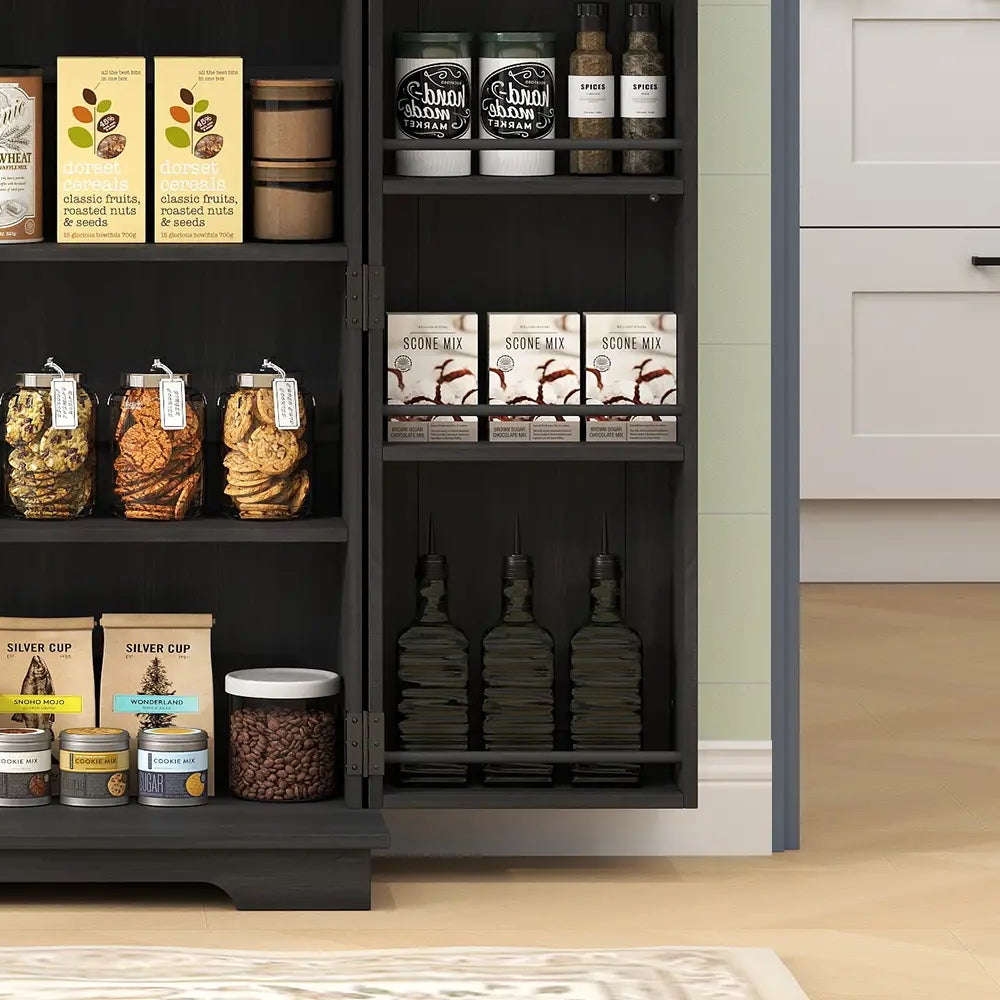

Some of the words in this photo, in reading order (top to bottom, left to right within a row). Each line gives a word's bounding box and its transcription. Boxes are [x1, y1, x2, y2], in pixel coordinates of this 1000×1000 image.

[63, 160, 121, 175] dorset
[160, 160, 218, 175] dorset
[63, 177, 128, 192] cereals
[160, 177, 226, 192] cereals
[64, 194, 102, 204] classic
[106, 194, 141, 206] fruits,
[160, 194, 199, 204] classic
[203, 194, 238, 206] fruits,
[64, 206, 107, 216] roasted
[110, 207, 136, 216] nuts
[160, 206, 204, 216] roasted
[207, 207, 233, 216] nuts
[64, 218, 73, 227] &
[76, 218, 108, 227] seeds
[160, 218, 170, 227] &
[174, 218, 205, 227] seeds
[404, 336, 438, 350] SCONE
[444, 336, 463, 350] MIX
[506, 336, 540, 350] SCONE
[546, 336, 565, 350] MIX
[602, 336, 637, 350] SCONE
[642, 336, 661, 350] MIX
[7, 643, 45, 652] SILVER
[49, 643, 72, 652] CUP
[126, 644, 164, 653] SILVER
[168, 644, 190, 653] CUP
